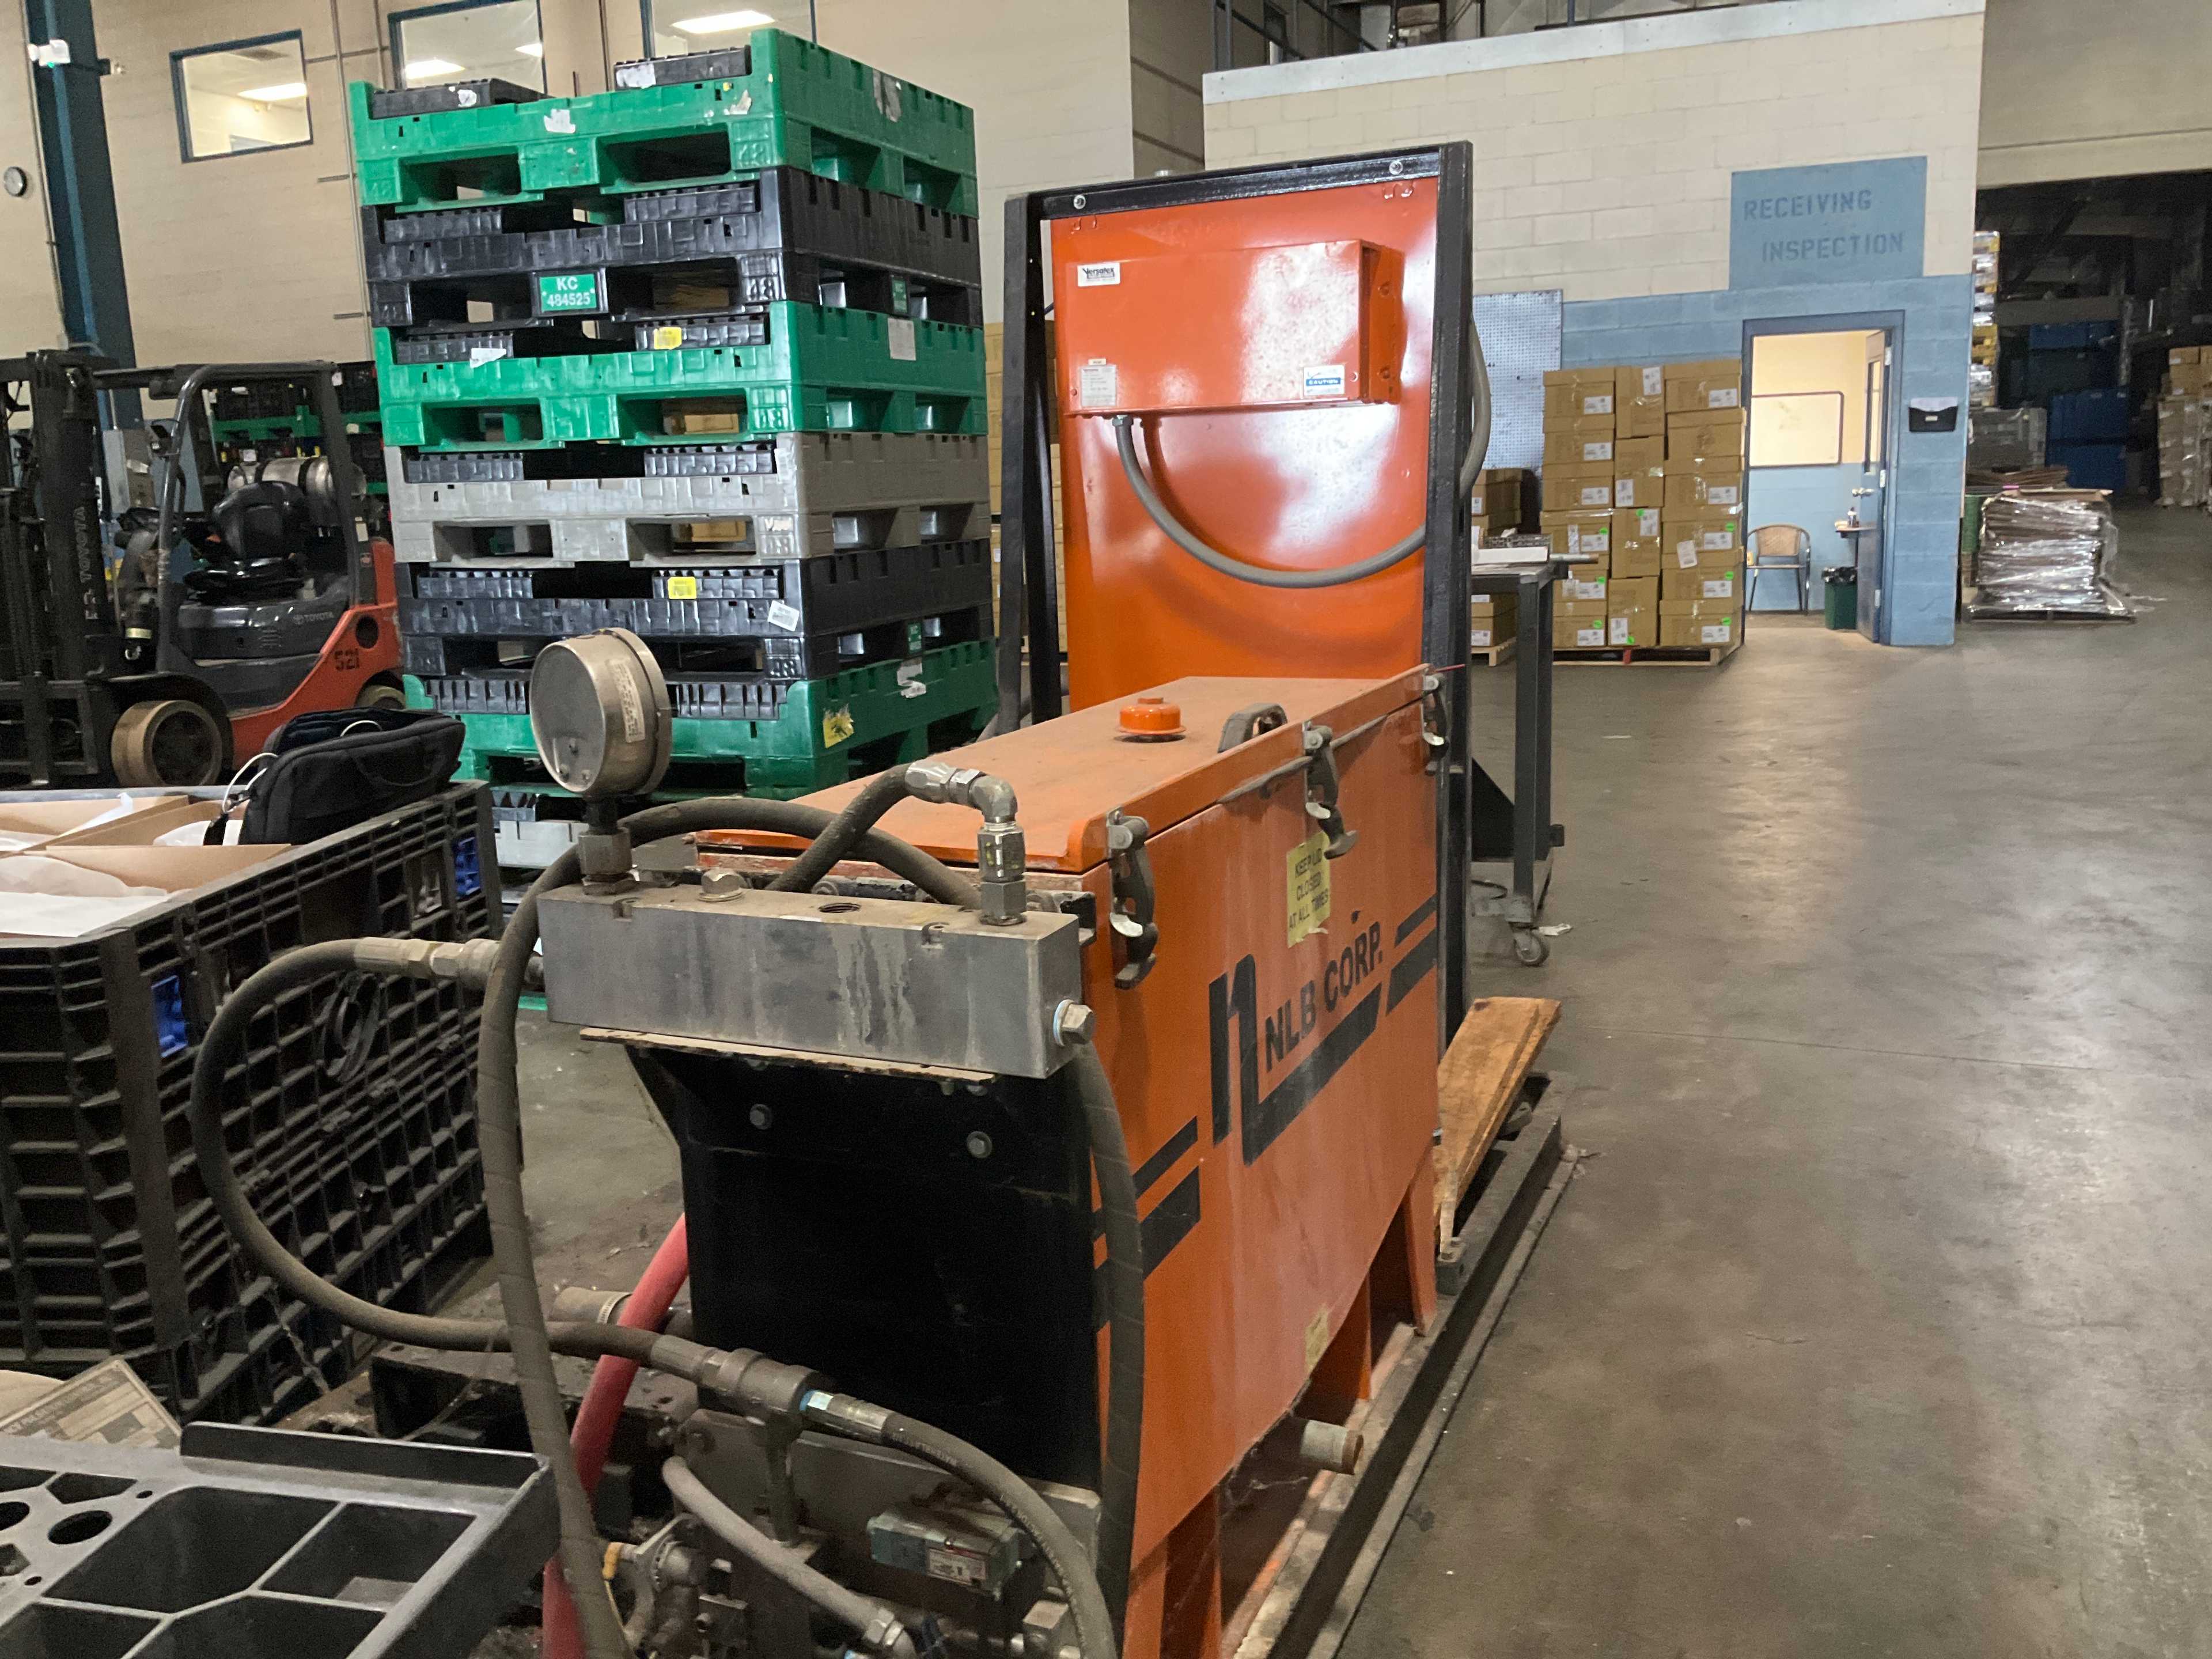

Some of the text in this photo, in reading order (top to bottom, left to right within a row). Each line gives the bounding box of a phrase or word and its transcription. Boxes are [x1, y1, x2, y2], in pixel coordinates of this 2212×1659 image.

[1744, 190, 1872, 221] RECEIVING
[1763, 232, 1904, 262] INSPECTION
[556, 276, 578, 290] KC
[547, 292, 590, 306] 484525
[73, 506, 92, 583] TOYOTA
[303, 611, 334, 622] TOYOTA
[1295, 854, 1312, 879] KEEP
[1297, 870, 1321, 901] CLOSED
[1289, 912, 1297, 929] AT
[1298, 904, 1310, 923] ALL
[1265, 921, 1382, 1074] NLB CORP.
